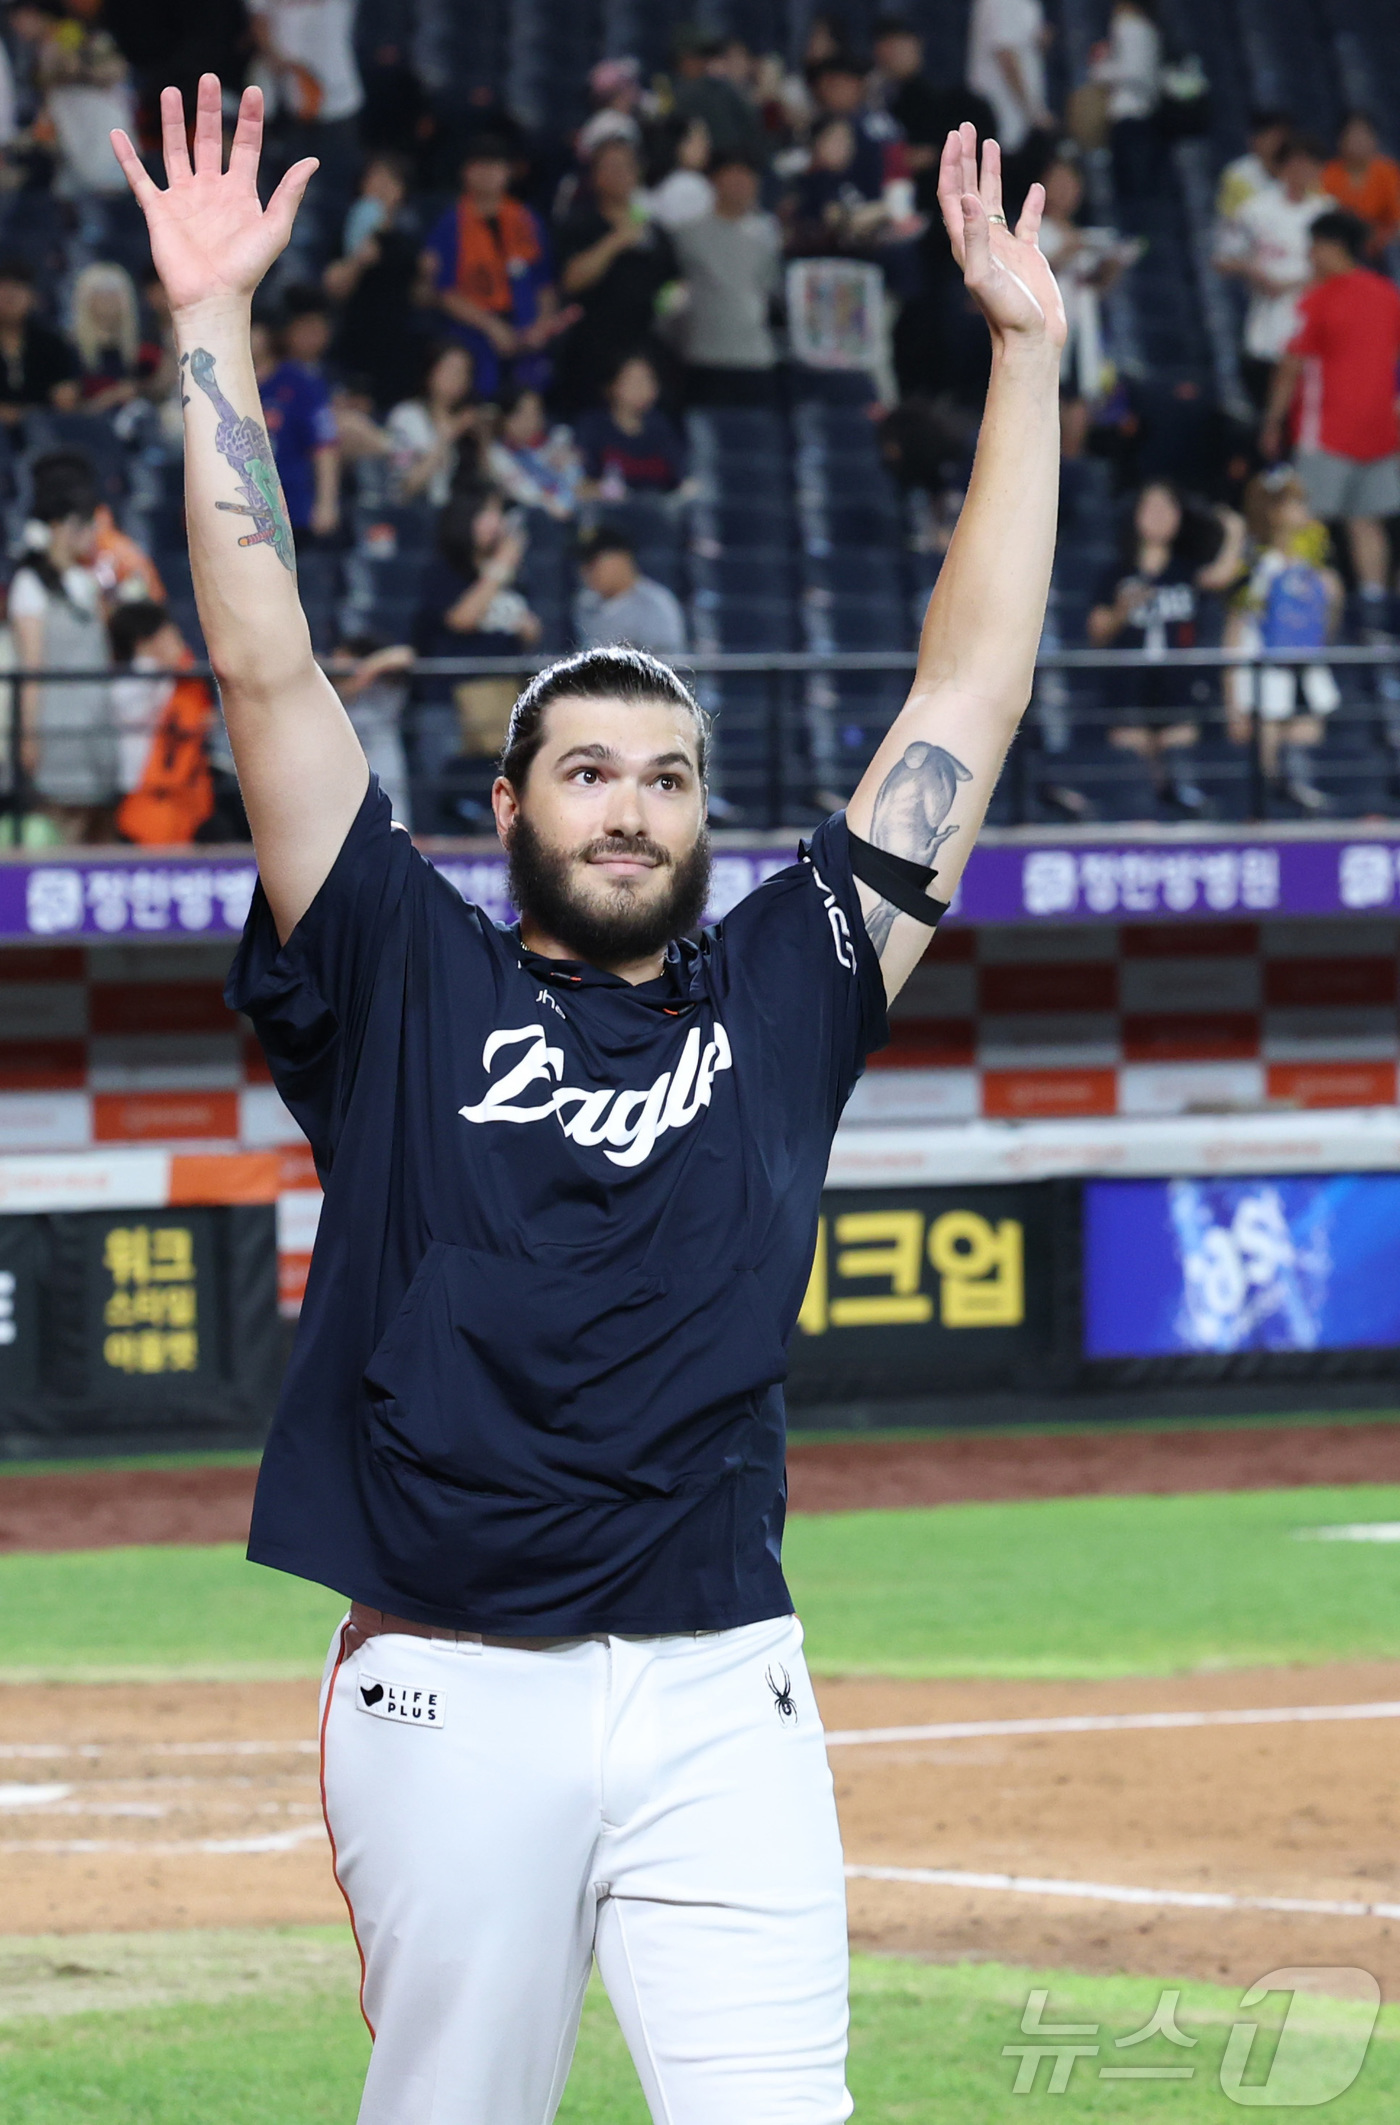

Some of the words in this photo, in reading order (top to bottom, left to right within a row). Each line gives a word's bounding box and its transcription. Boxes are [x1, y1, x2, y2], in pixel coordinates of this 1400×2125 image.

[797, 1212, 1025, 1336] 크업
[389, 1688, 437, 1705] LIFE
[388, 1702, 436, 1720] PLUS
